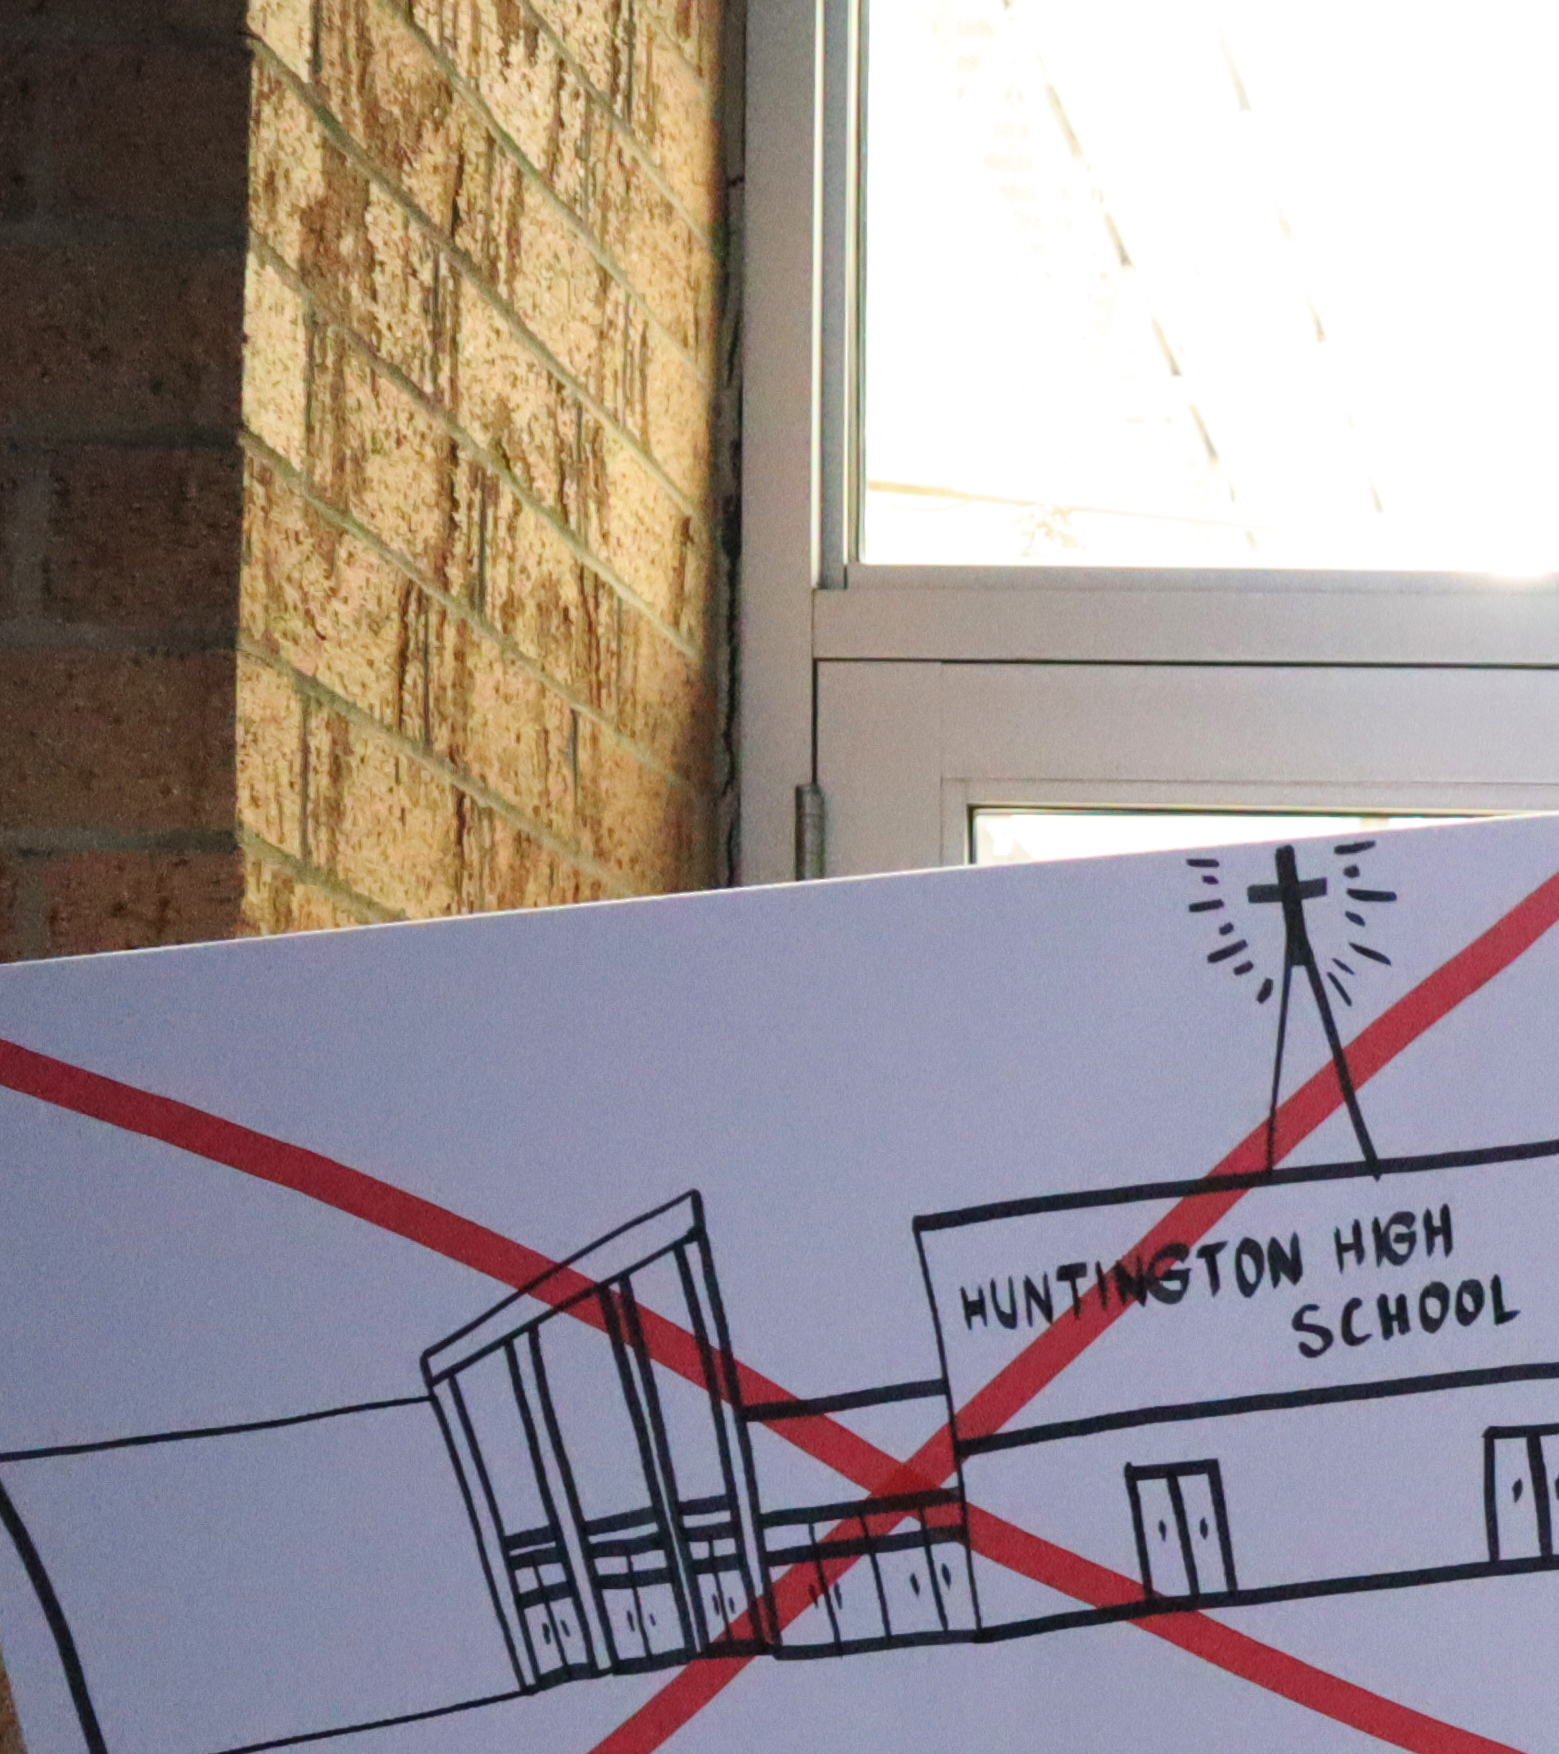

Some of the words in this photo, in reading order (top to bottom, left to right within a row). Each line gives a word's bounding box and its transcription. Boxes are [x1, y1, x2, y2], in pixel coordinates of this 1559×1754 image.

[959, 1232, 1303, 1331] HUNTINGTON
[1334, 1203, 1453, 1272] HIGH
[1291, 1274, 1521, 1360] SCHOOL
